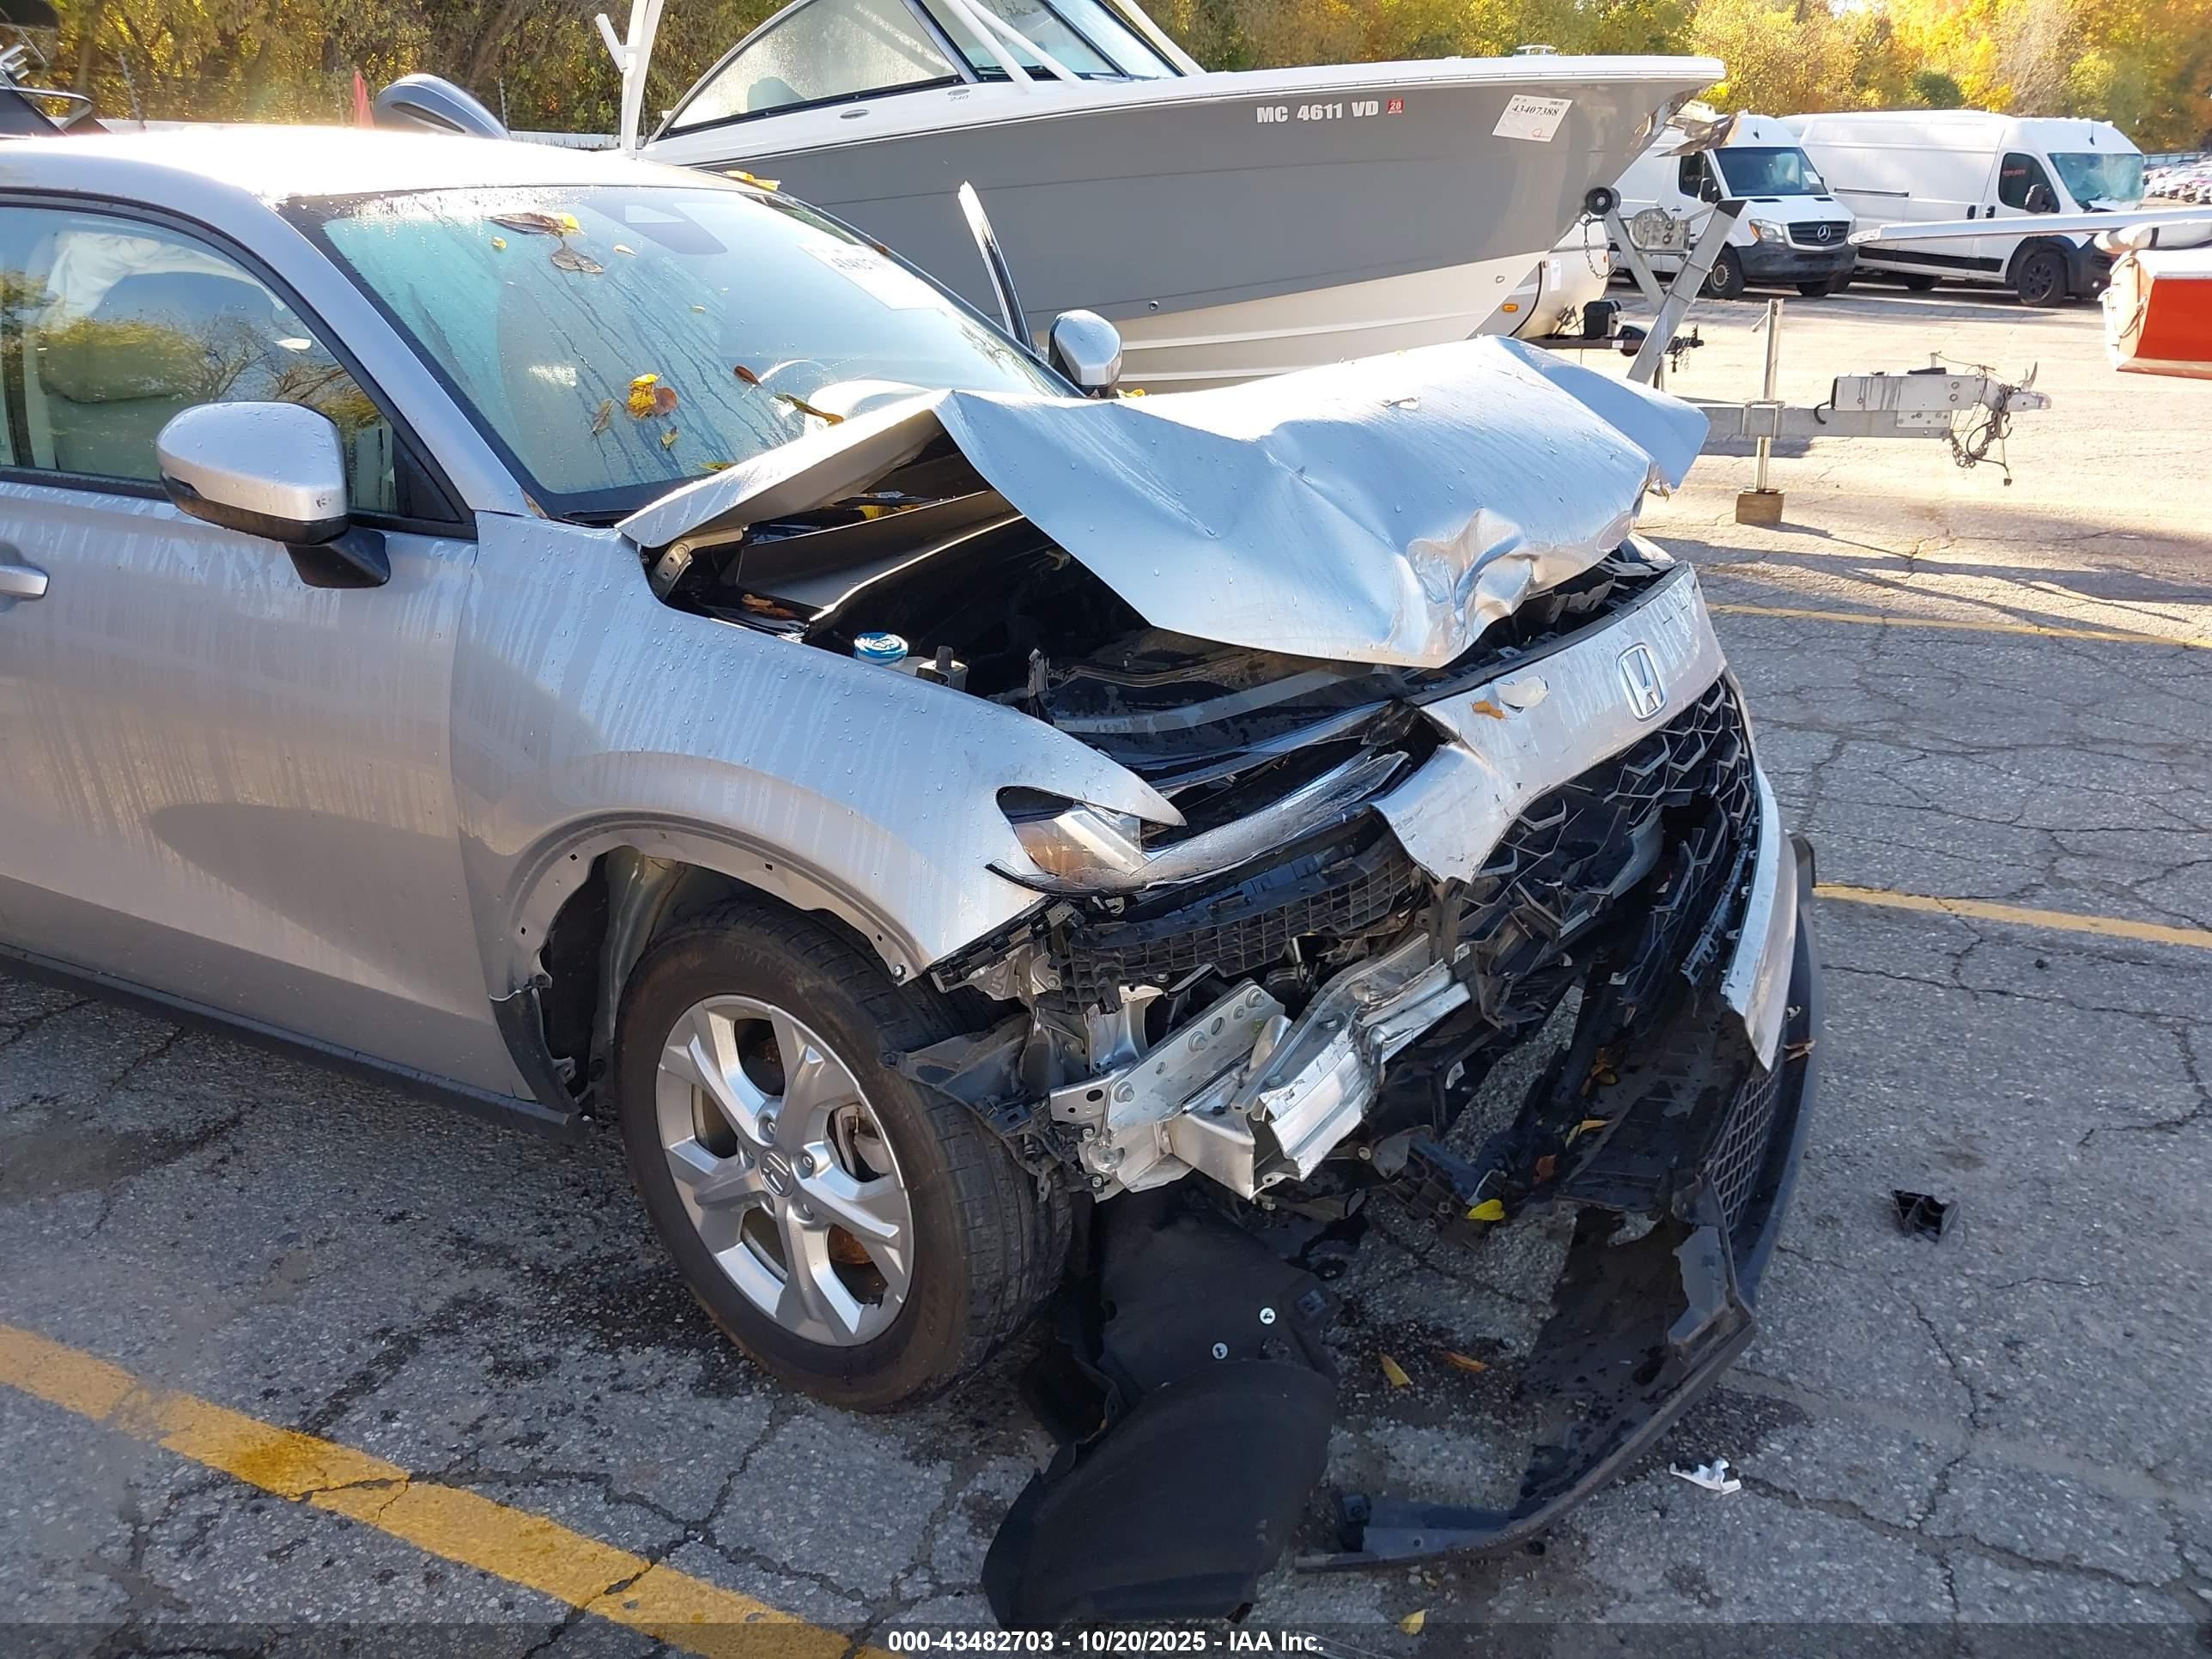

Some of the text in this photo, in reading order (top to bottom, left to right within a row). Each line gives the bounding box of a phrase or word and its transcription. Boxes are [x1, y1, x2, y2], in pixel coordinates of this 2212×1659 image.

[1256, 100, 1379, 123] MC 4611 VD
[1512, 104, 1559, 117] 43407388
